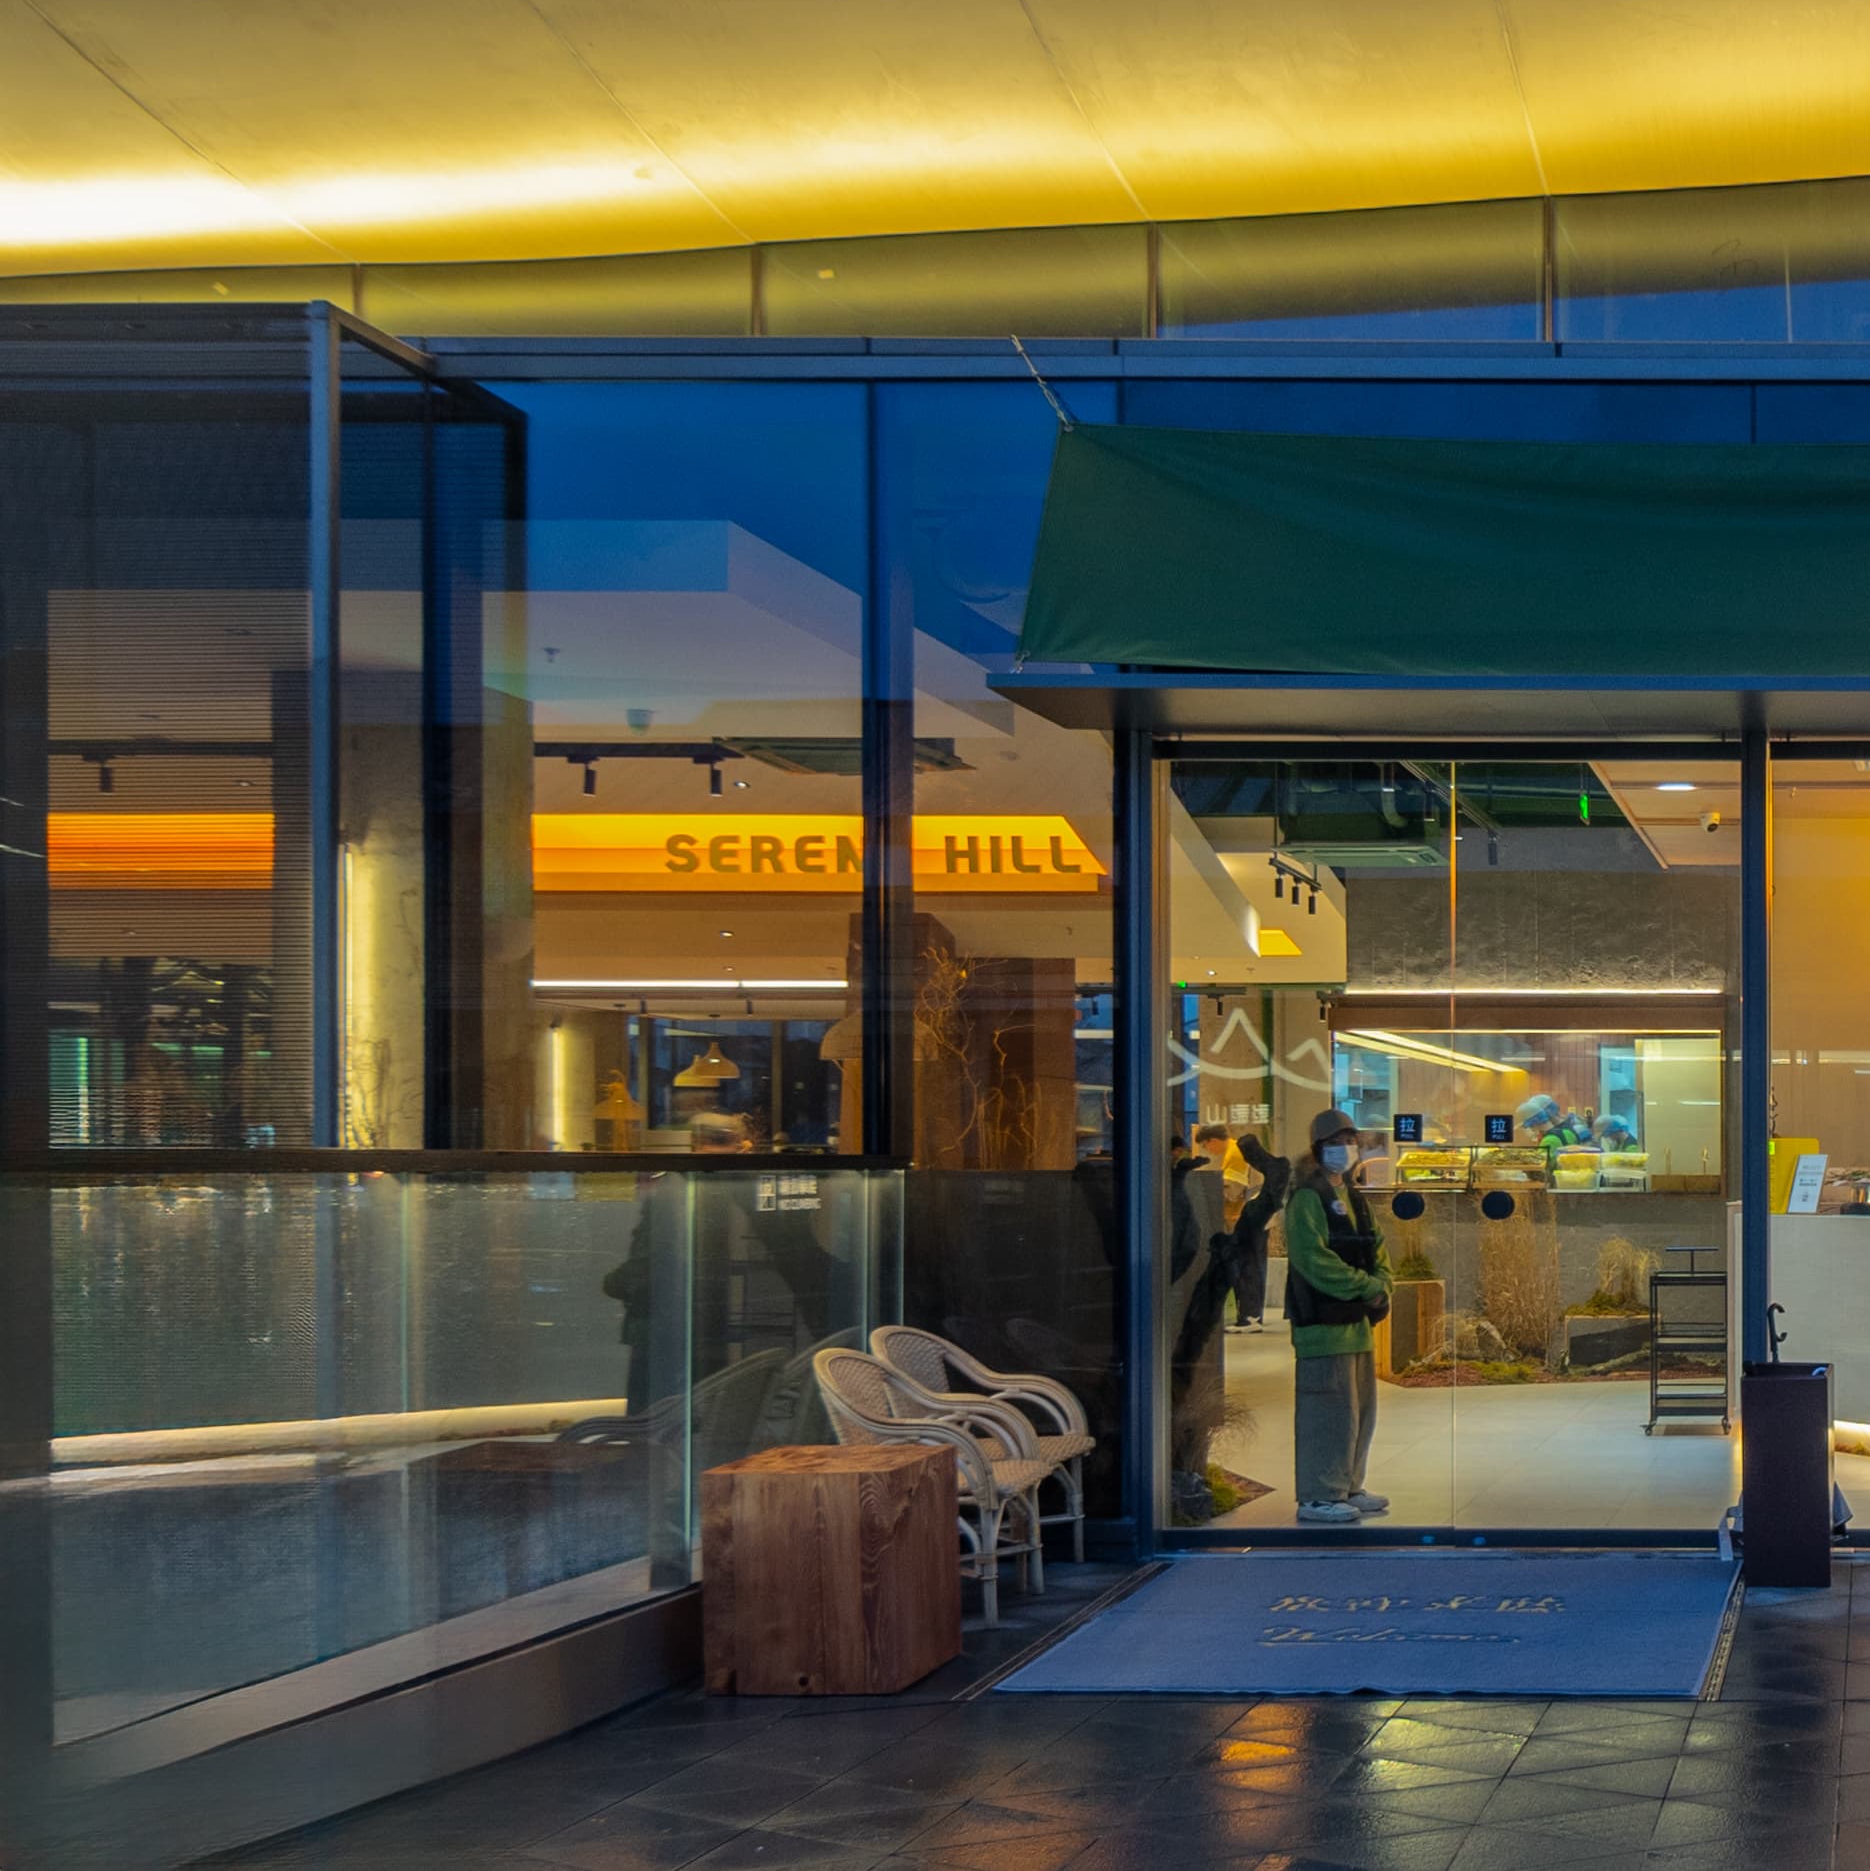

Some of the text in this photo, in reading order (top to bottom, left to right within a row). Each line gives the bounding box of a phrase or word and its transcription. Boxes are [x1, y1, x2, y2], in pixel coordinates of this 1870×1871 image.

[665, 834, 1082, 874] SEREN HILL
[1399, 1116, 1416, 1132] 拉
[1491, 1117, 1506, 1133] 拉
